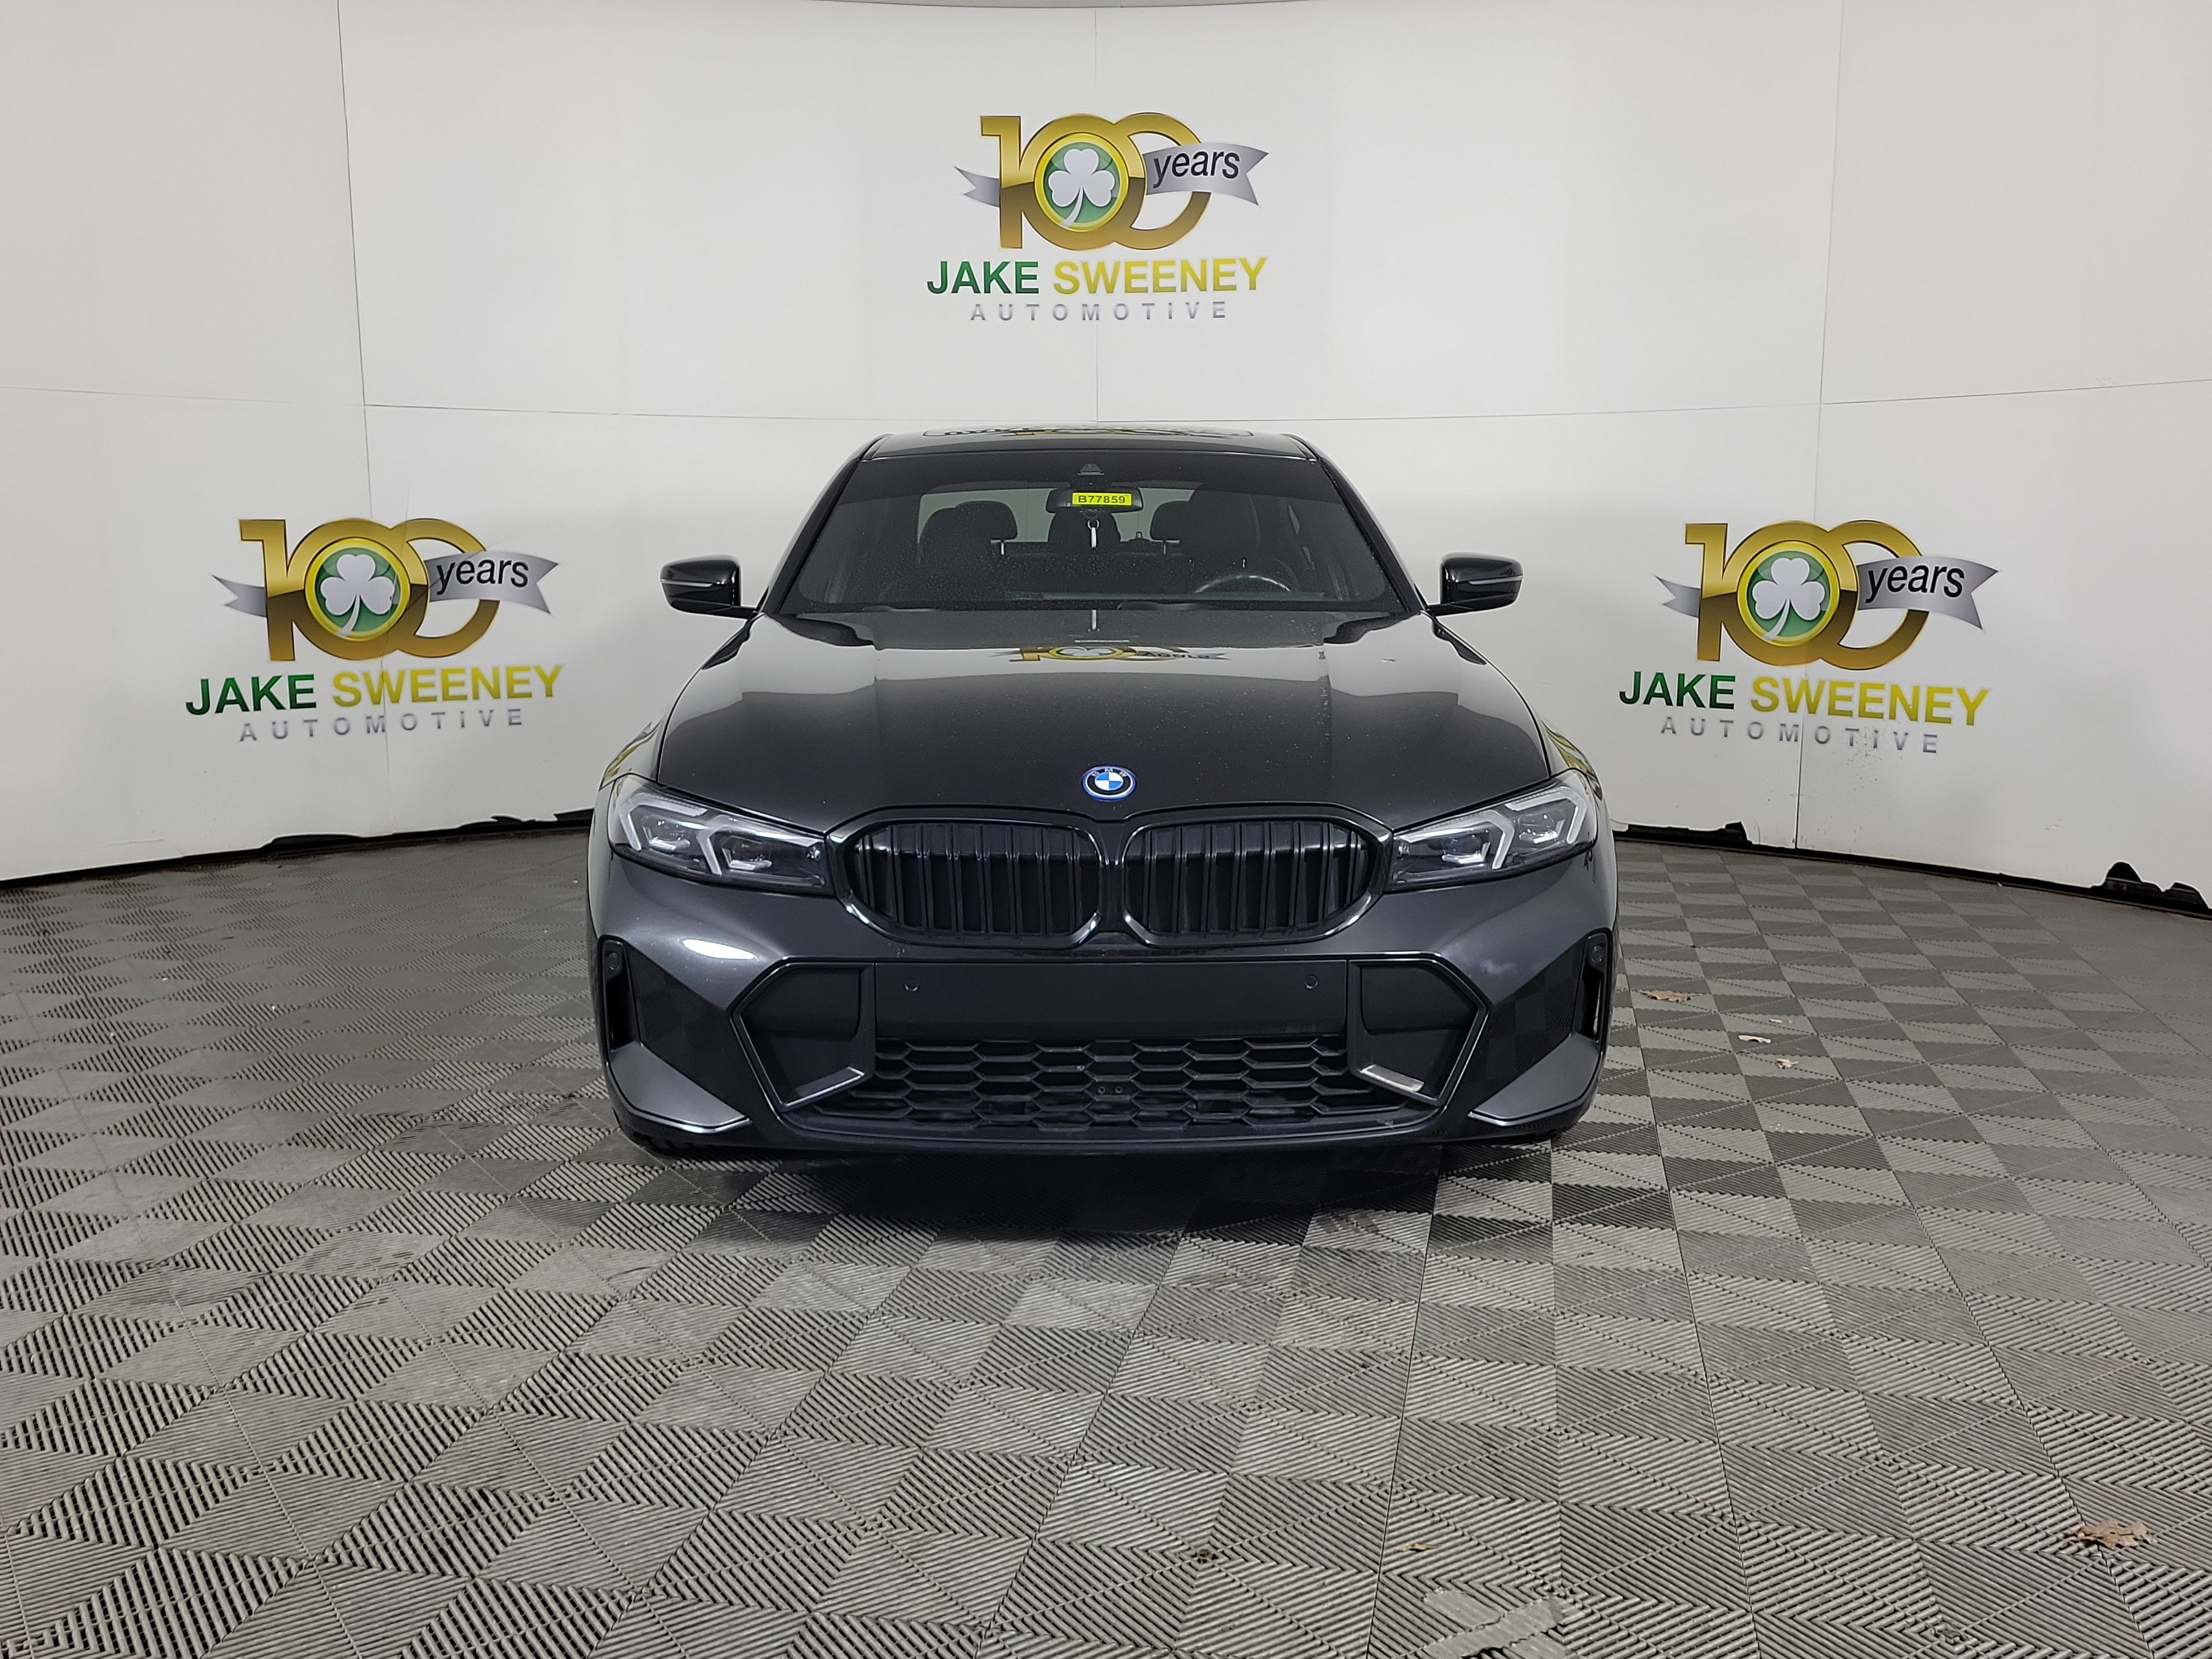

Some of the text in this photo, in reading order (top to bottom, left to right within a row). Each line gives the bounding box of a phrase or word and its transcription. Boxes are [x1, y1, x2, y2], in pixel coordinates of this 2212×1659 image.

[1152, 150, 1240, 188] years
[927, 257, 1267, 295] JAKE SWEENEY
[970, 301, 1226, 321] AUTOMOTIVE
[1078, 495, 1125, 504] B77859
[436, 558, 529, 595] years
[1865, 564, 1965, 603] years
[185, 664, 563, 715] JAKE SWEENEY
[1619, 671, 1990, 726] JAKE SWEENEY
[240, 708, 522, 742] AUTOMOTIVE
[1661, 716, 1938, 753] AUTOMOTIVE
